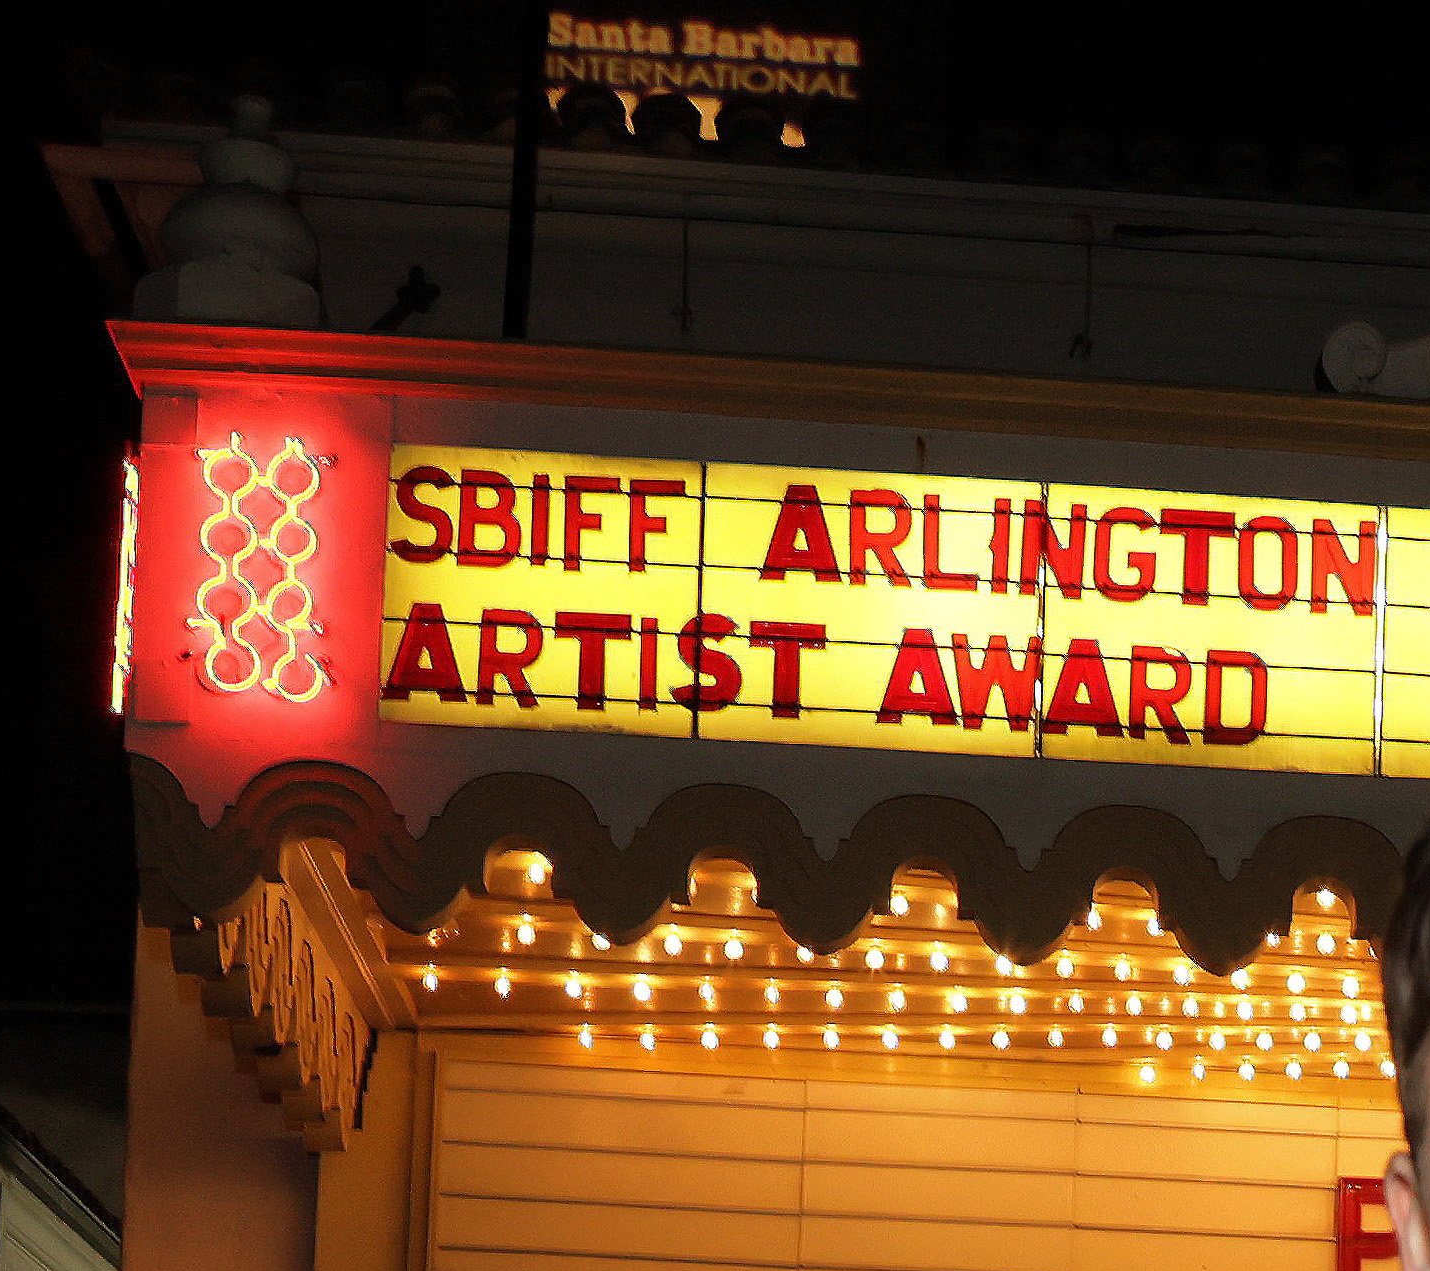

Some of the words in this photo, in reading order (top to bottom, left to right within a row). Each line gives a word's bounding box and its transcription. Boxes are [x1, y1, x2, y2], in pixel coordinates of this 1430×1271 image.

[544, 52, 857, 101] INTERNATIONAL
[547, 11, 673, 54] Santa
[681, 20, 859, 67] Barbara
[390, 465, 685, 574] SBIFF
[759, 484, 1378, 617] ARLINGTON
[381, 602, 827, 718] ARTIST
[876, 628, 1269, 746] AWARD
